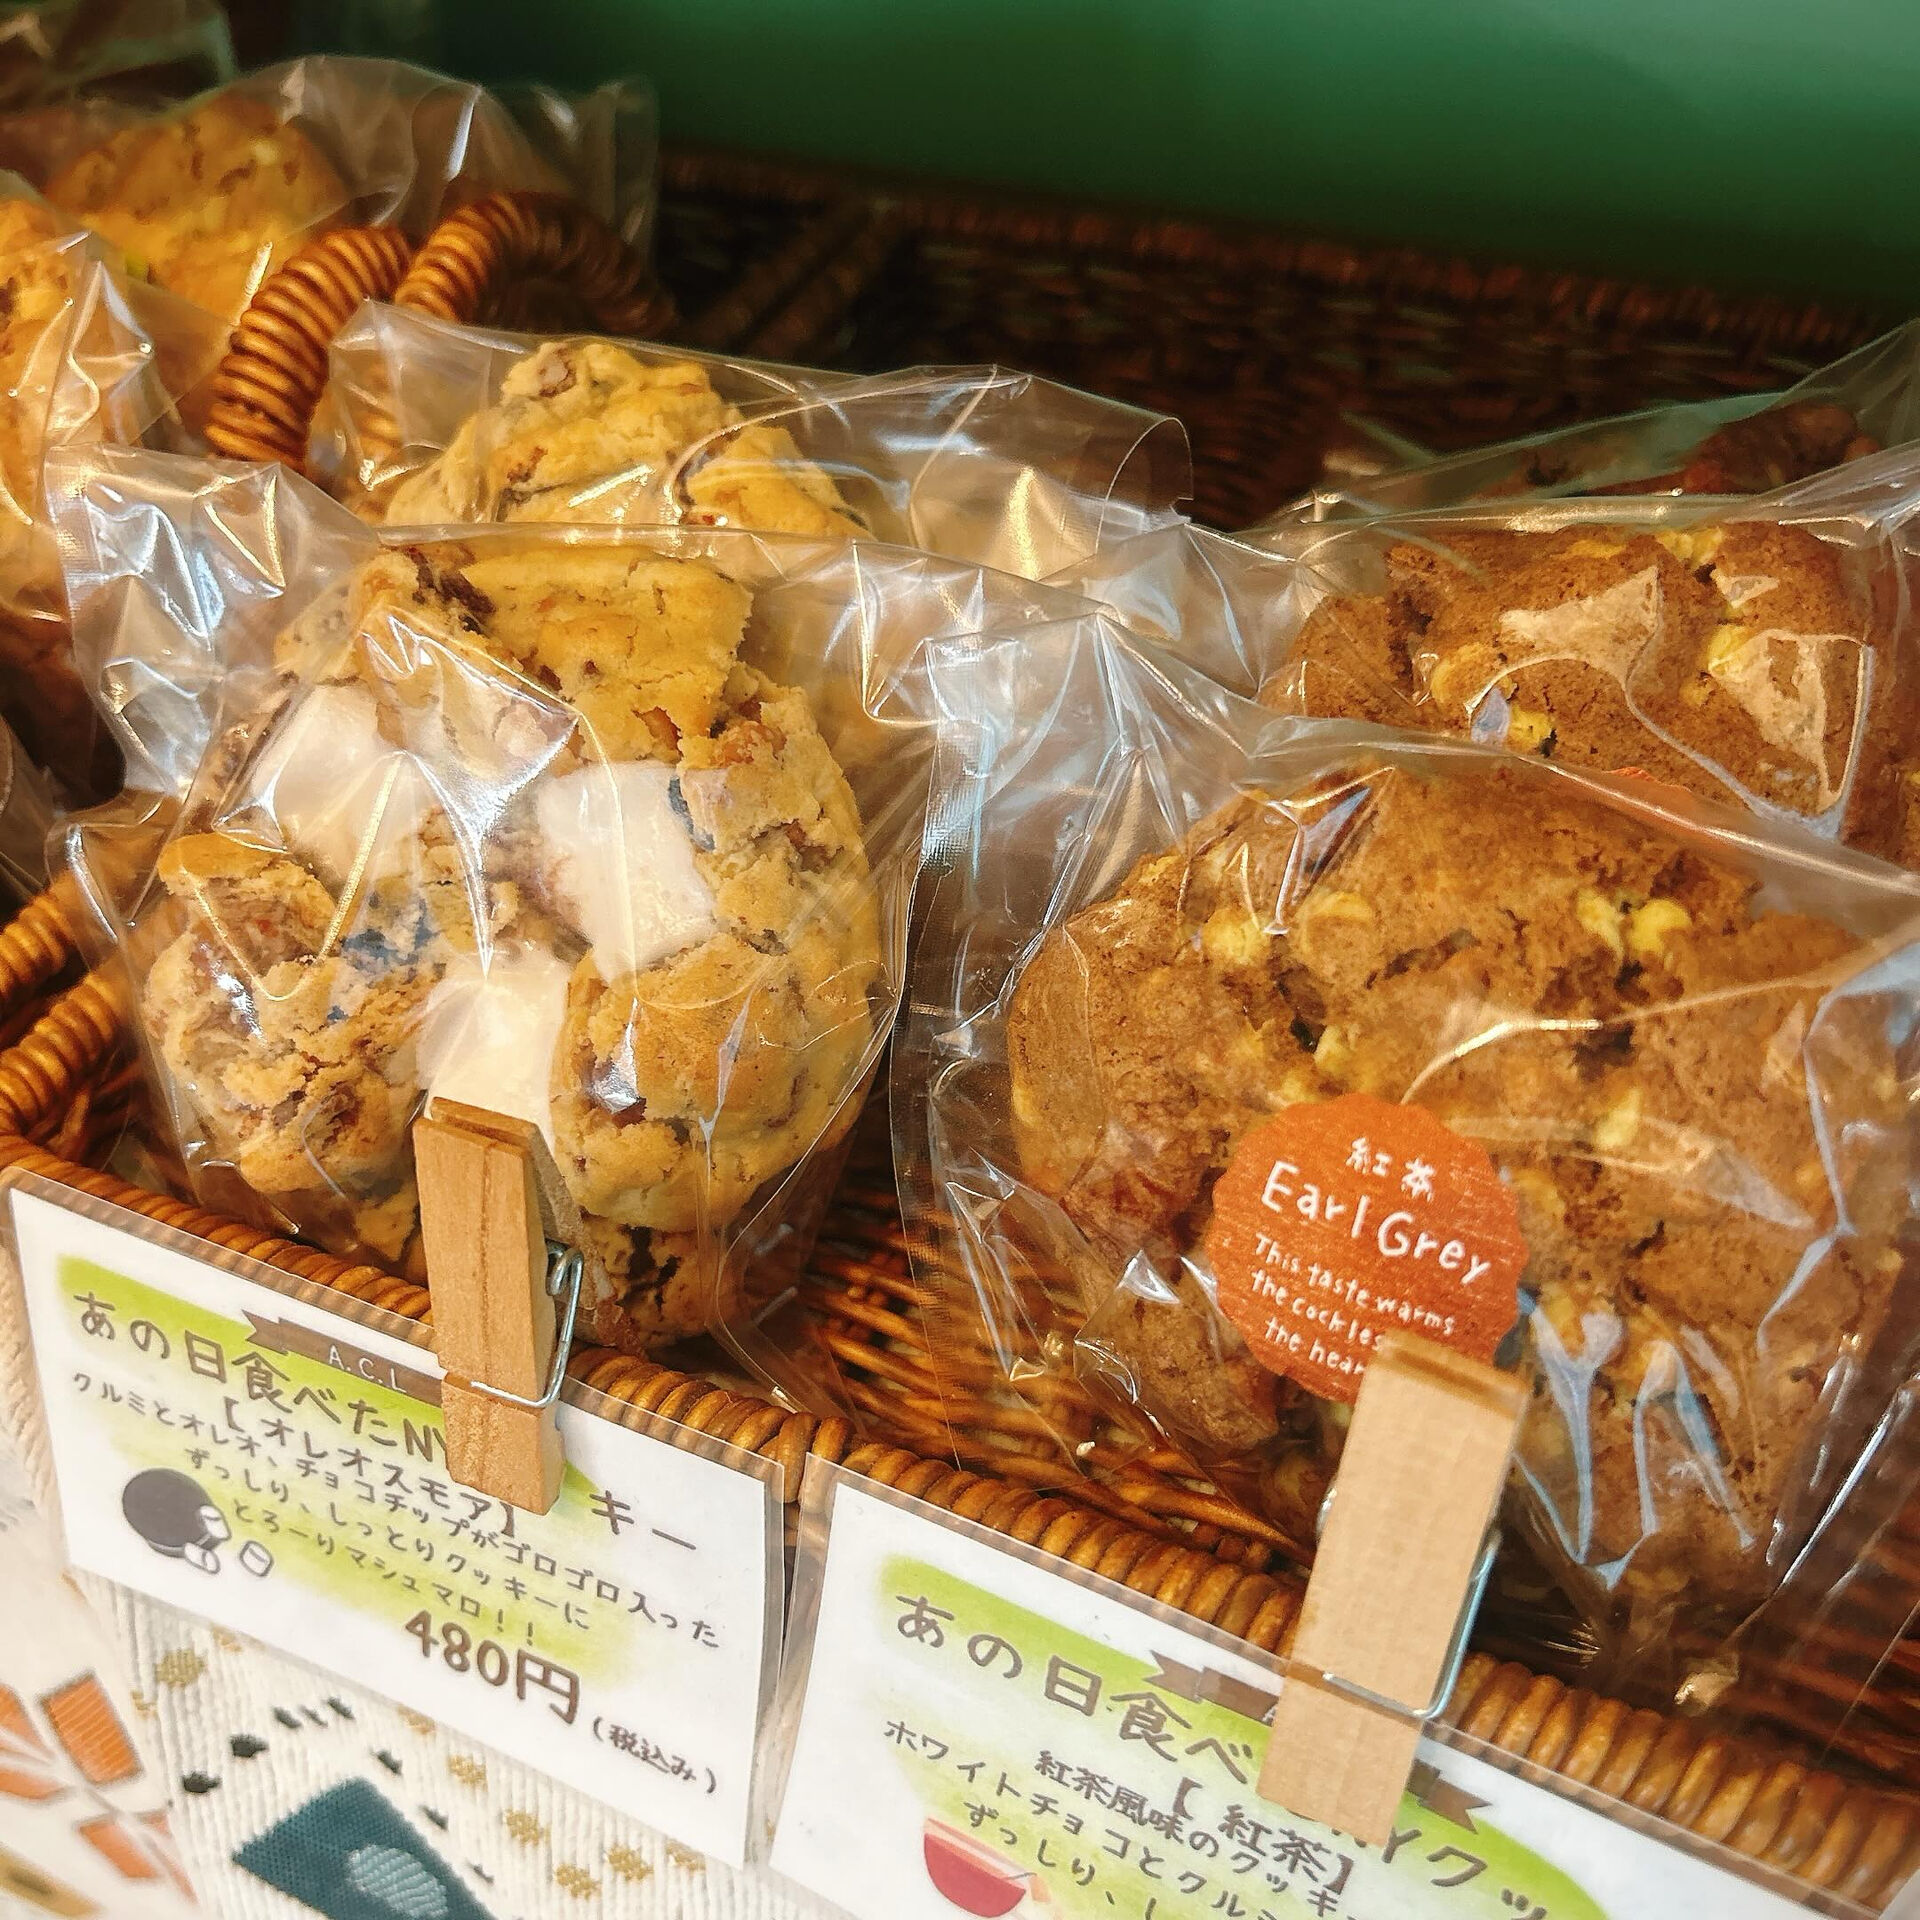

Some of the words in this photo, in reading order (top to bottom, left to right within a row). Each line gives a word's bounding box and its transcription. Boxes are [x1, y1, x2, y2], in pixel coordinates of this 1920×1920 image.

[1260, 1160, 1371, 1238] Earl
[1377, 1211, 1491, 1286] Grey
[1346, 1137, 1435, 1202] 紅茶
[1250, 1269, 1288, 1307] the
[1254, 1232, 1299, 1274] This
[1307, 1261, 1370, 1308] taste
[1375, 1292, 1456, 1336] warms
[1265, 1316, 1302, 1352] the
[1308, 1336, 1366, 1376] hear
[404, 1609, 580, 1725] 480円
[1033, 1749, 1356, 1920] 紅茶風味のクッキ
[1172, 1775, 1355, 1895] 【紅茶】
